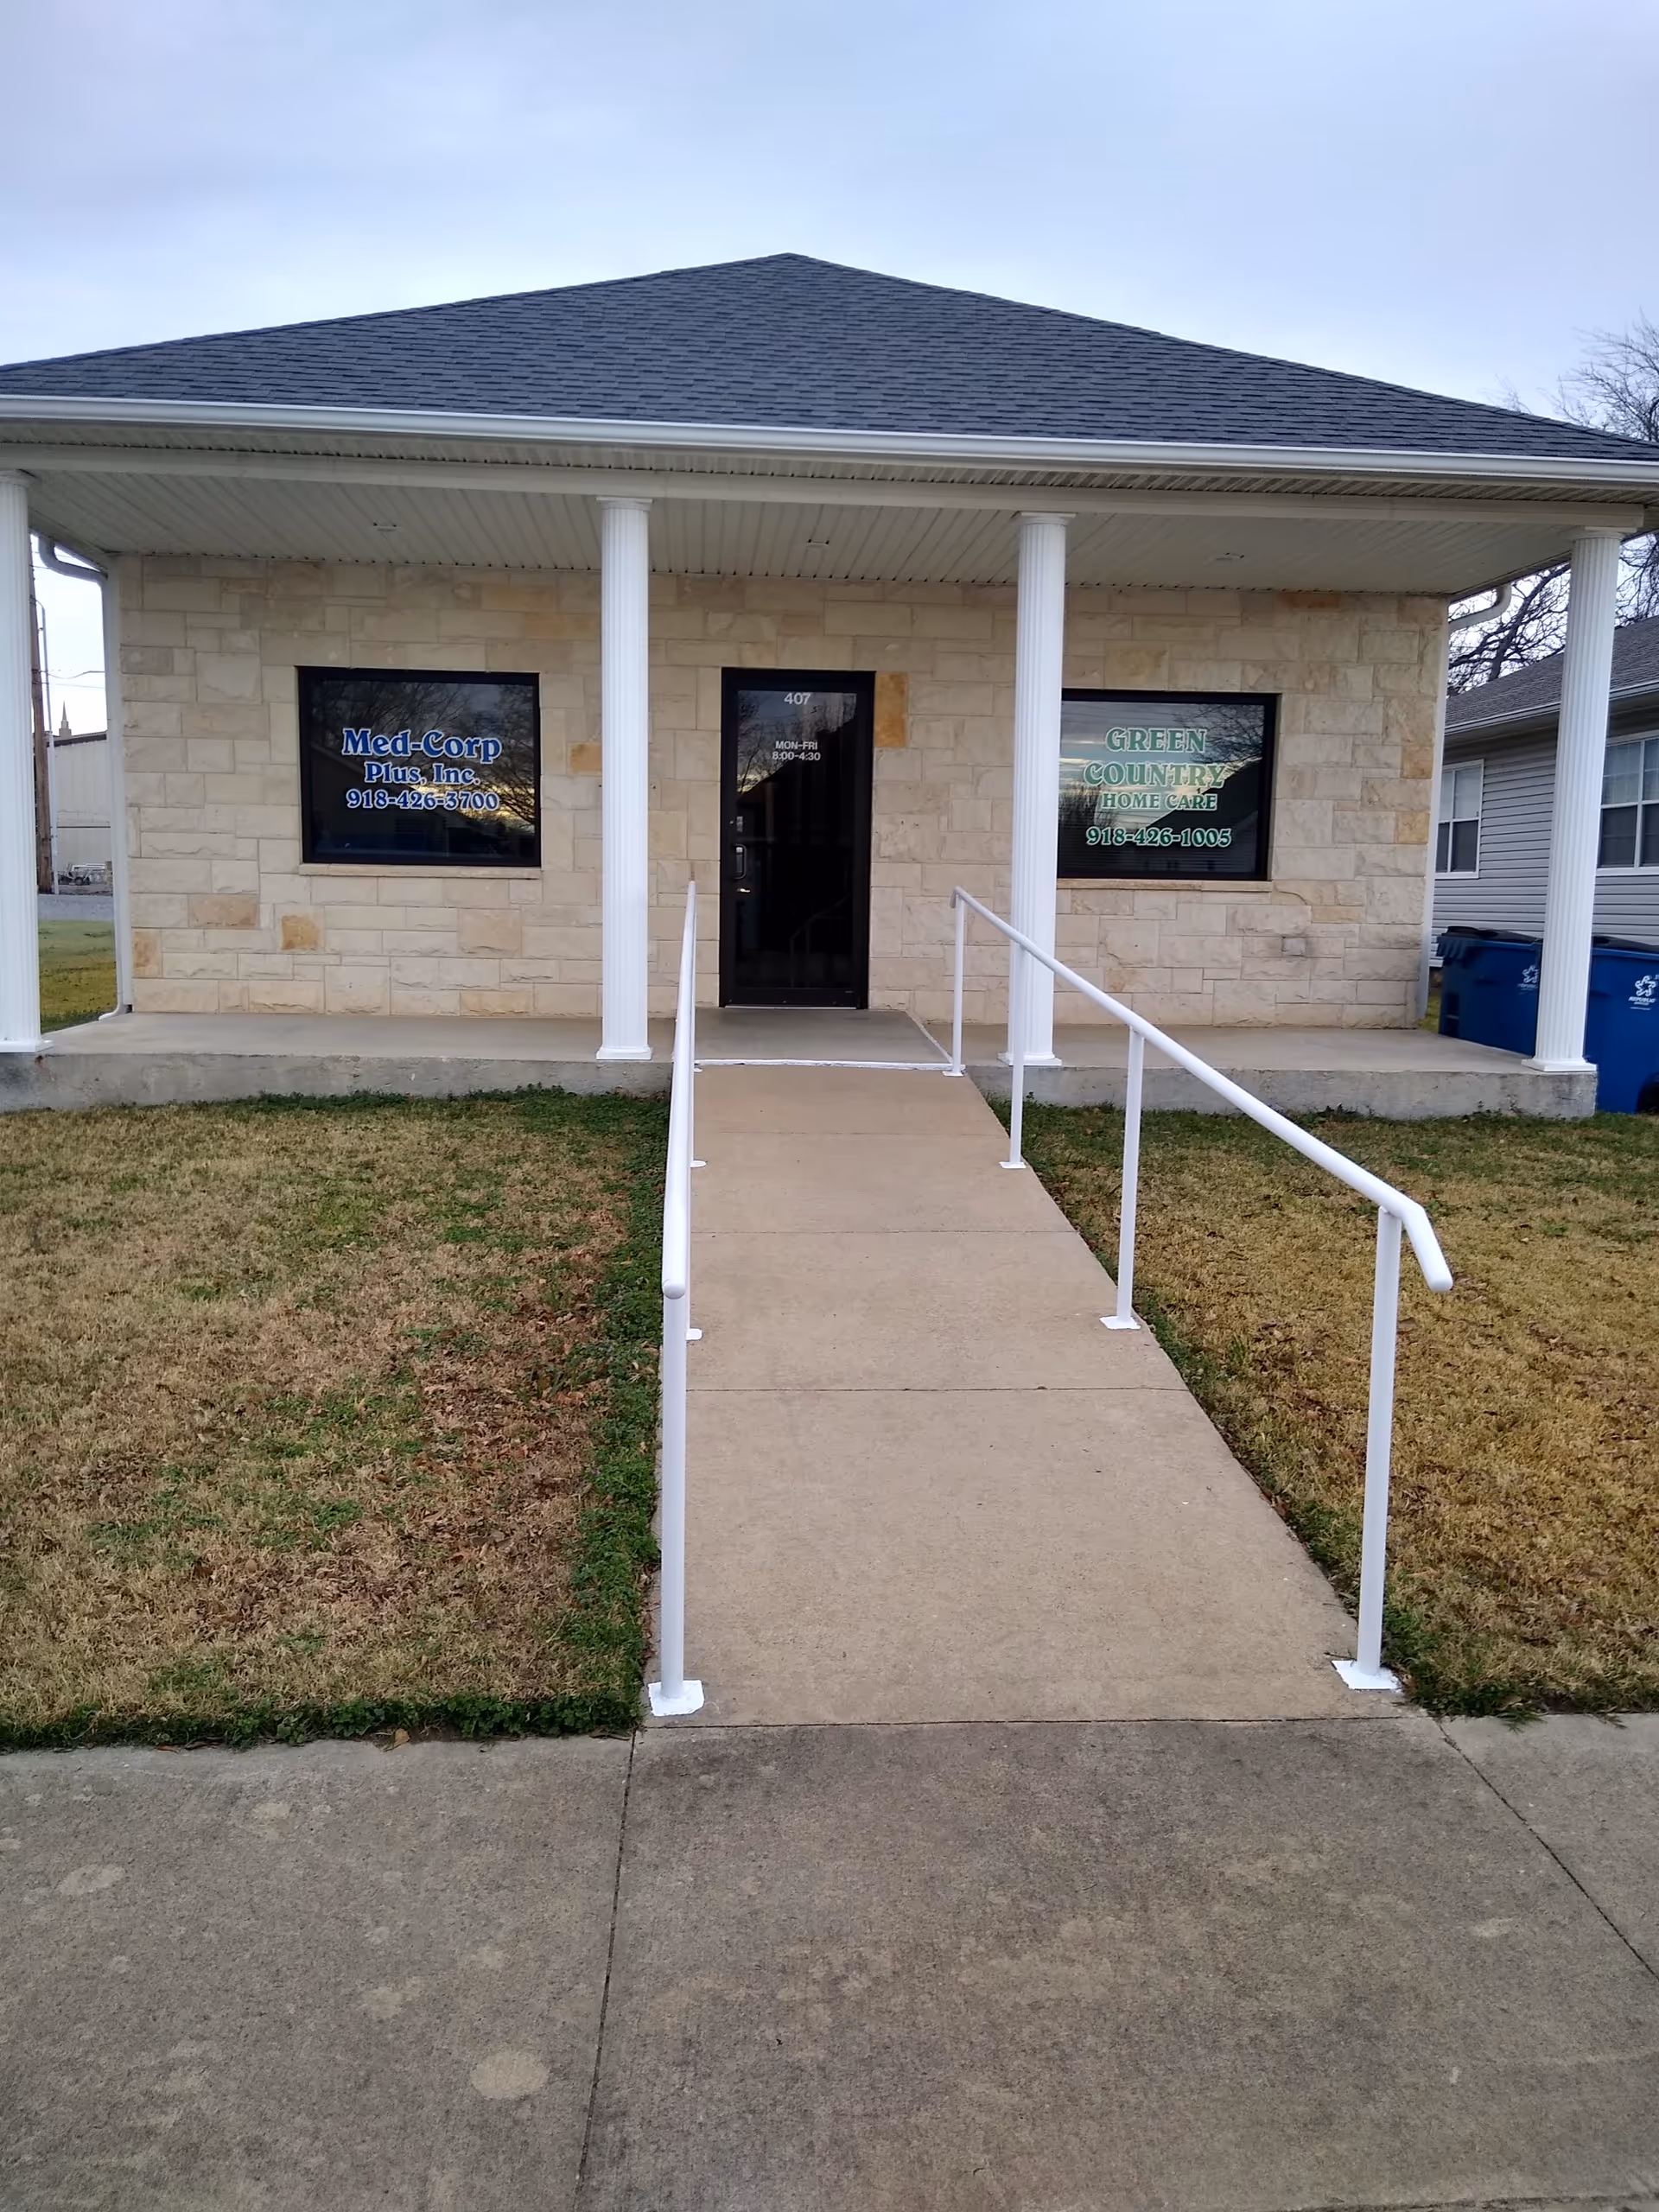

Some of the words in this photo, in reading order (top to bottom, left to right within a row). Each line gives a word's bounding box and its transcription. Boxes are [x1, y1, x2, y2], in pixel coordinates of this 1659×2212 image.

[784, 692, 810, 705] 407
[341, 728, 501, 763] Med-Corp
[775, 741, 818, 750] MON-FRI
[1106, 728, 1207, 753] GREEN
[772, 751, 821, 760] 8:00-4:30
[364, 761, 427, 785] Plus,
[433, 763, 481, 785] Inc.
[1084, 761, 1228, 788] COUNTRY
[346, 789, 499, 810] 918-426-3700
[1102, 792, 1160, 810] HOME
[1166, 794, 1218, 811] CARE
[1085, 826, 1232, 848] 918-426-1005
